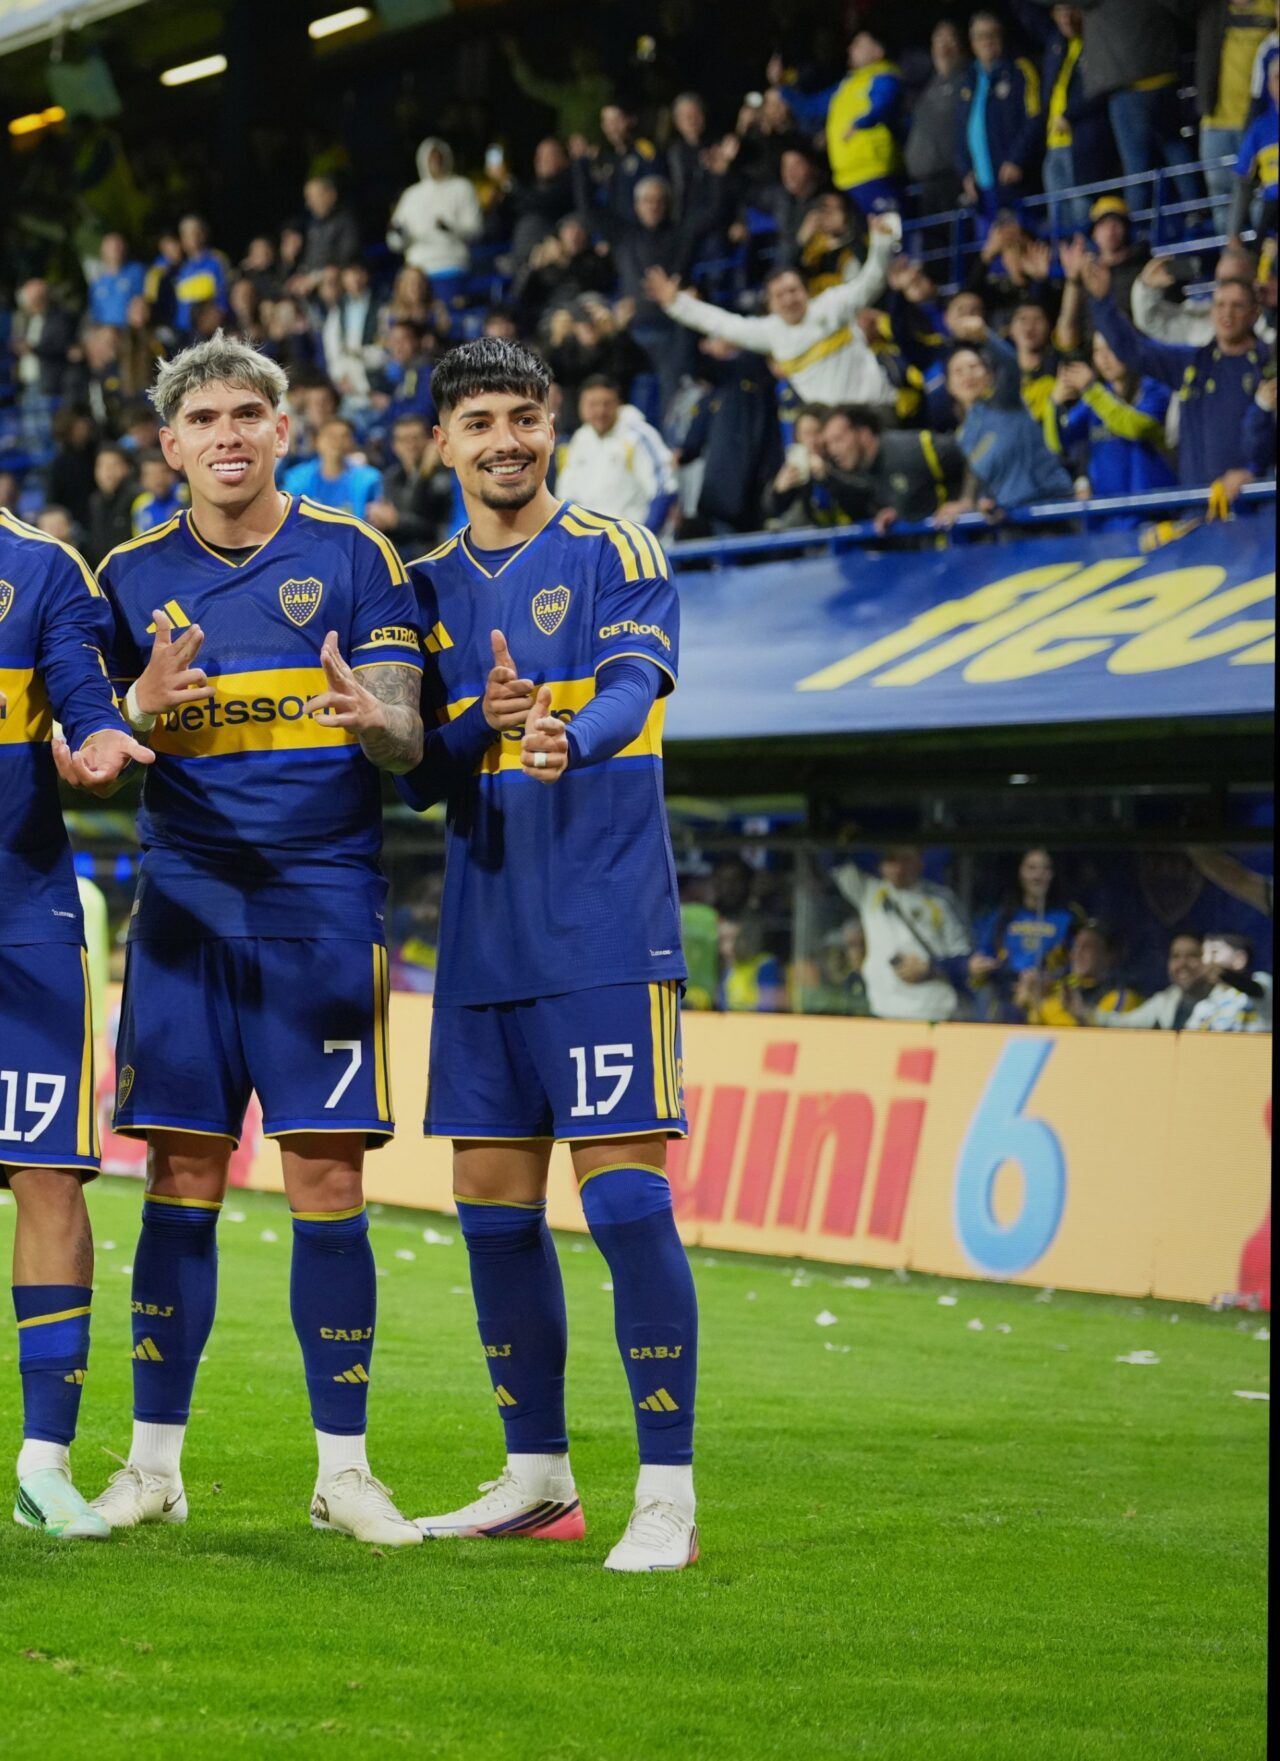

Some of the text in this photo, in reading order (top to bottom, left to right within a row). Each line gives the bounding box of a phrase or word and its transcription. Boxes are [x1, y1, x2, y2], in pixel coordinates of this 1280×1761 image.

[284, 592, 317, 605] CABJ
[536, 601, 565, 615] CABJ
[370, 626, 418, 644] CETRO
[598, 620, 671, 651] CETROGAR
[795, 556, 1275, 692] flec
[324, 1040, 362, 1109] 7
[569, 1043, 634, 1117] 15
[666, 1041, 937, 1244] uini
[956, 1037, 1067, 1277] 6
[320, 1327, 372, 1342] CABJ
[630, 1345, 682, 1360] CABJ
